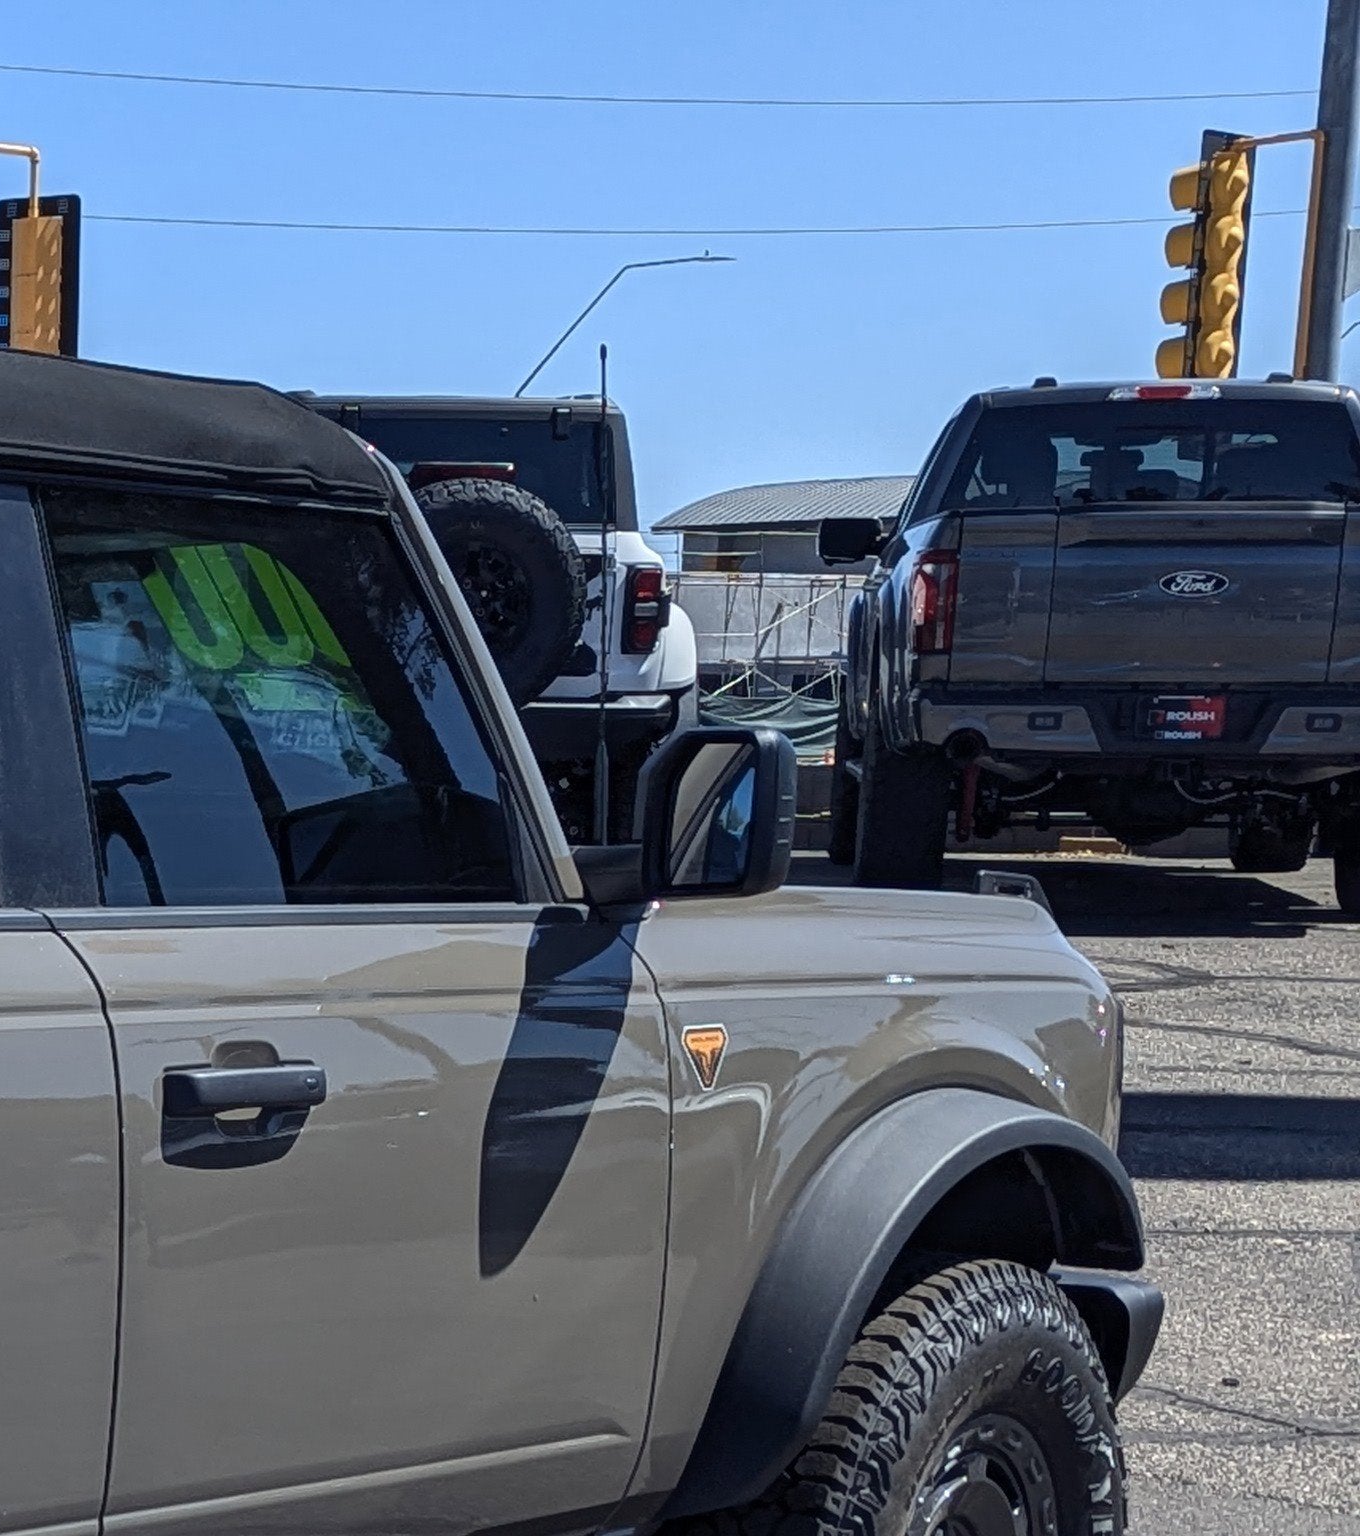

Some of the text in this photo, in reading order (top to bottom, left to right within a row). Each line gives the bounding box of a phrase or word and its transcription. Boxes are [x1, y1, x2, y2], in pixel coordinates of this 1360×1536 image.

[1168, 572, 1218, 594] Ford
[1166, 710, 1216, 722] ROUSH
[1164, 730, 1202, 740] ROUSH
